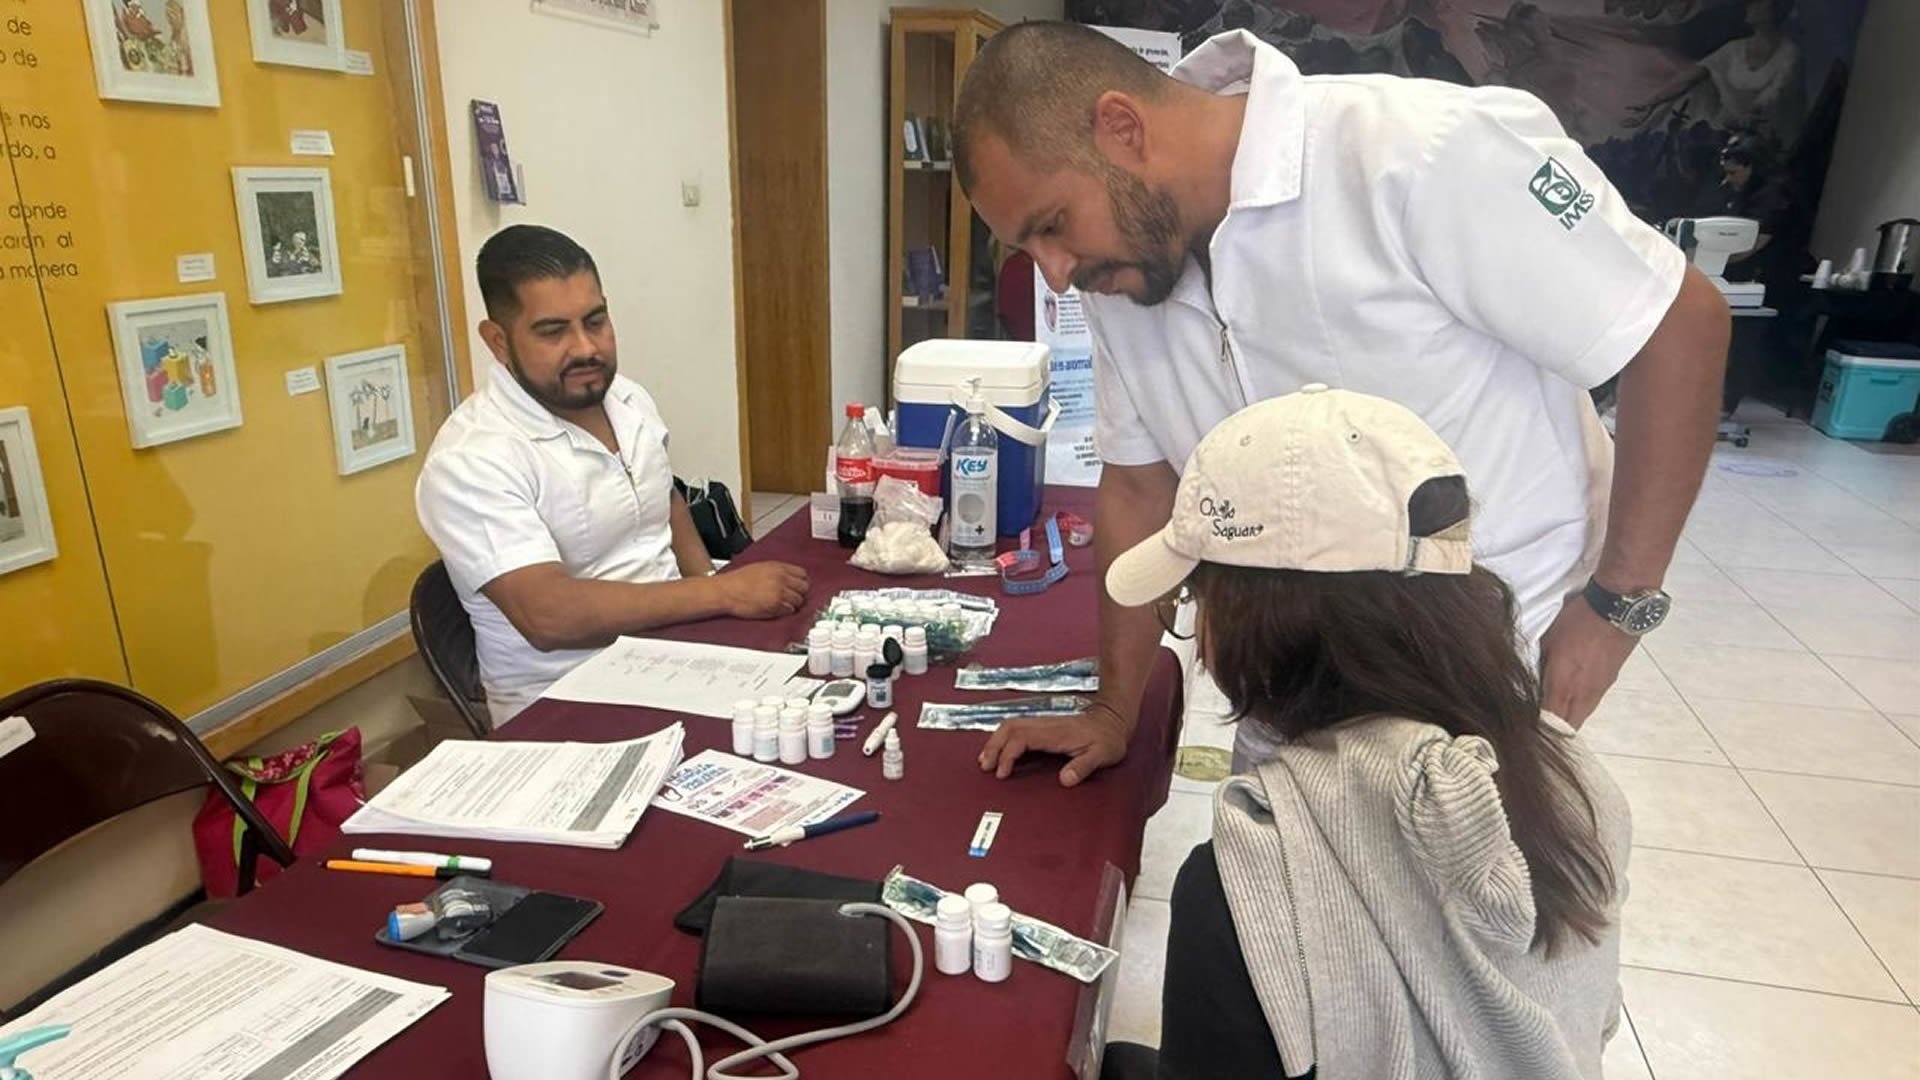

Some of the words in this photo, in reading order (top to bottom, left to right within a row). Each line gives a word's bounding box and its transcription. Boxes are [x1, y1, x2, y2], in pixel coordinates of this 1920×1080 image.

[7, 16, 32, 36] de
[13, 48, 38, 68] de
[19, 113, 51, 129] nos
[43, 144, 56, 160] a
[57, 231, 73, 248] al
[10, 263, 79, 279] manera
[956, 457, 988, 475] KEY
